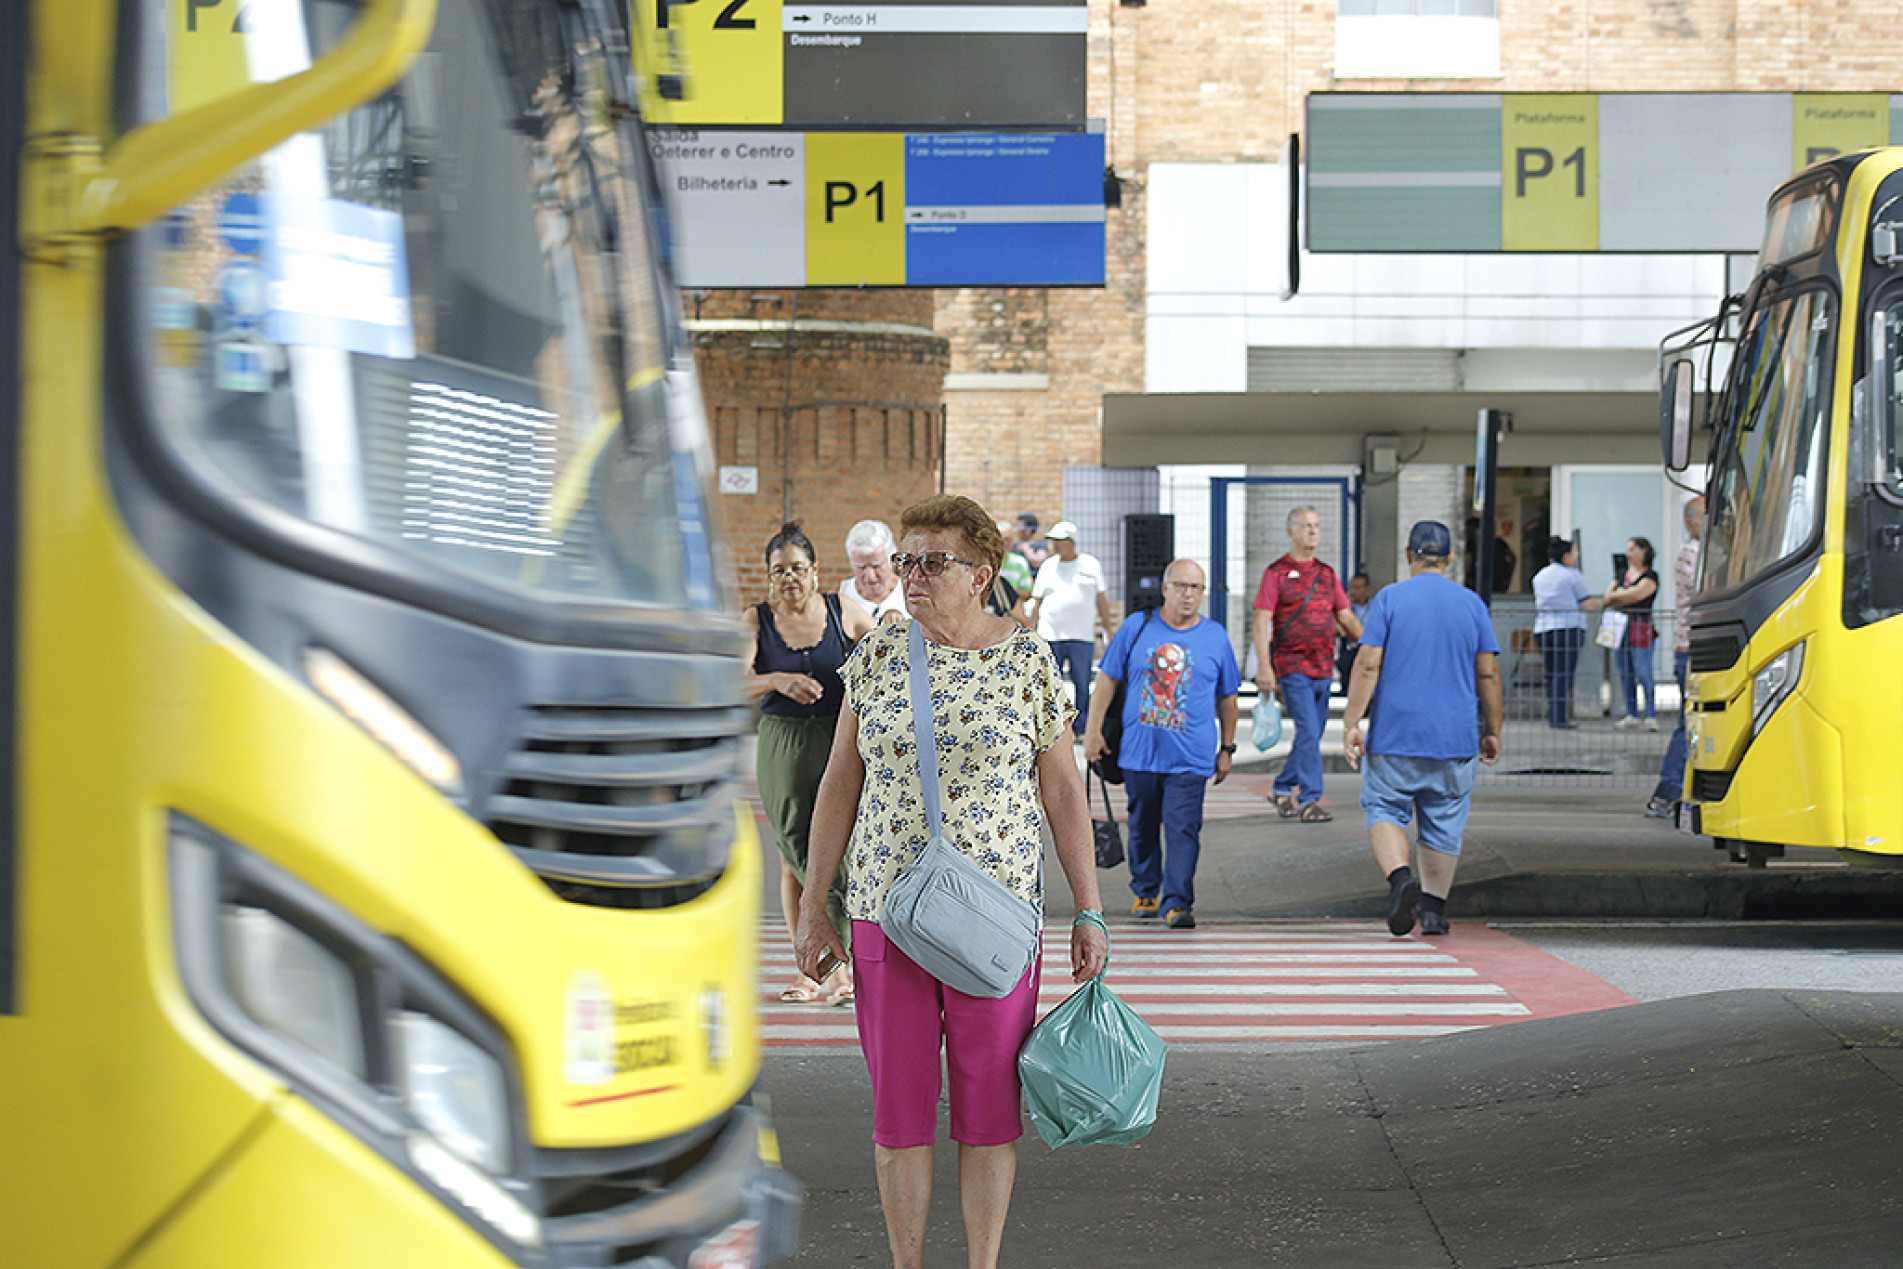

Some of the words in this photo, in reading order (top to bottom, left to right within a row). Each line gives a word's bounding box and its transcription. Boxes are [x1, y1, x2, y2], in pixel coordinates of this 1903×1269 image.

[823, 12, 863, 25] Ponto
[866, 12, 876, 25] H
[720, 148, 731, 159] e
[735, 143, 796, 159] Centro
[1516, 147, 1585, 197] P1
[677, 175, 758, 190] Bilheteria
[825, 181, 884, 223] P1
